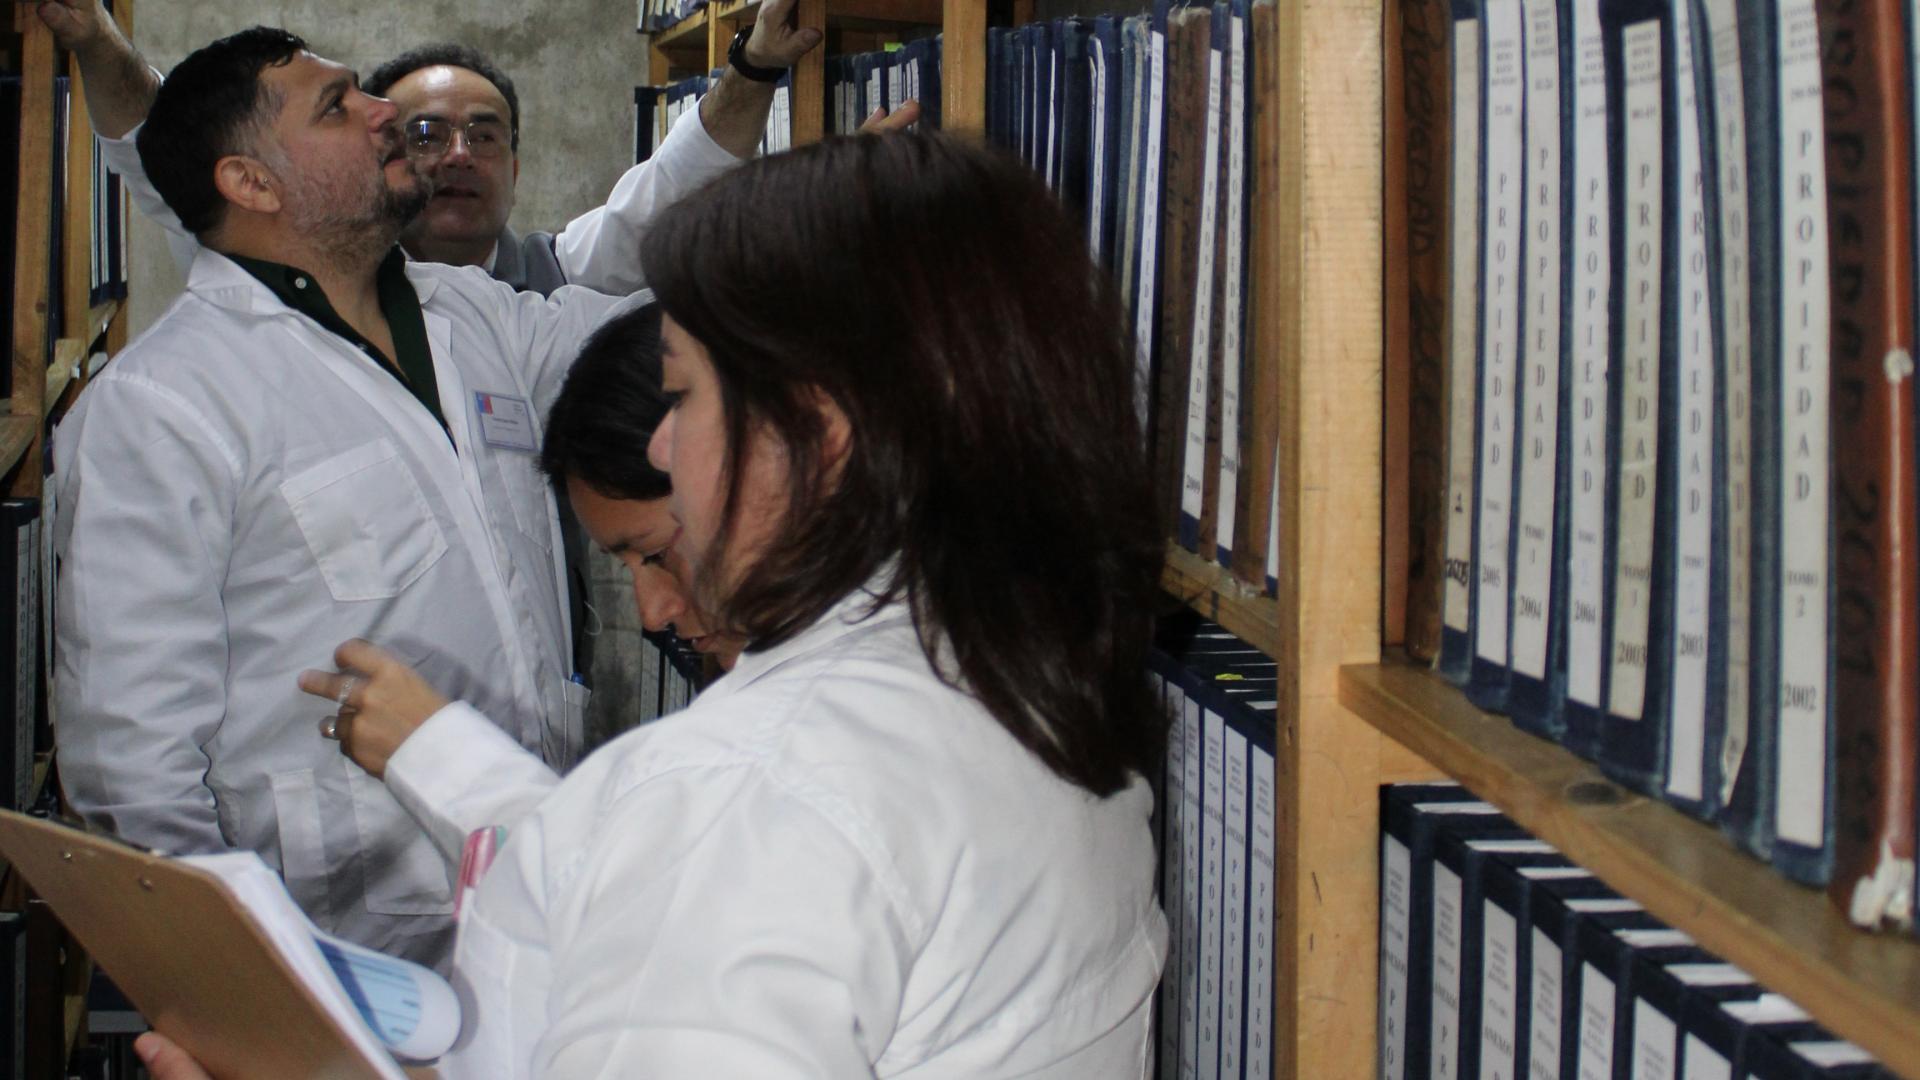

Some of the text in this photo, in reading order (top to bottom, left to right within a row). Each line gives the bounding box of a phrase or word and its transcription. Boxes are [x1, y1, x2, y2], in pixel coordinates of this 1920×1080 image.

[1492, 173, 1507, 465] PROPIEDAD
[1534, 148, 1549, 460] PROPIEDAD
[1583, 178, 1599, 493] PROPIEDAD
[1634, 163, 1650, 499] PROPIEDAD
[1691, 170, 1704, 514] PROPIEDAD
[1796, 129, 1814, 500] PROPIEDAD
[1482, 565, 1500, 588] 2005
[1518, 594, 1542, 621] 2004
[1574, 594, 1596, 624] 2004
[1617, 640, 1647, 668] 2003
[1680, 632, 1704, 659] 2003
[1784, 682, 1817, 713] 2002
[1205, 836, 1216, 1043] PROPIEDAD
[1226, 858, 1238, 1069] PROPIEDAD
